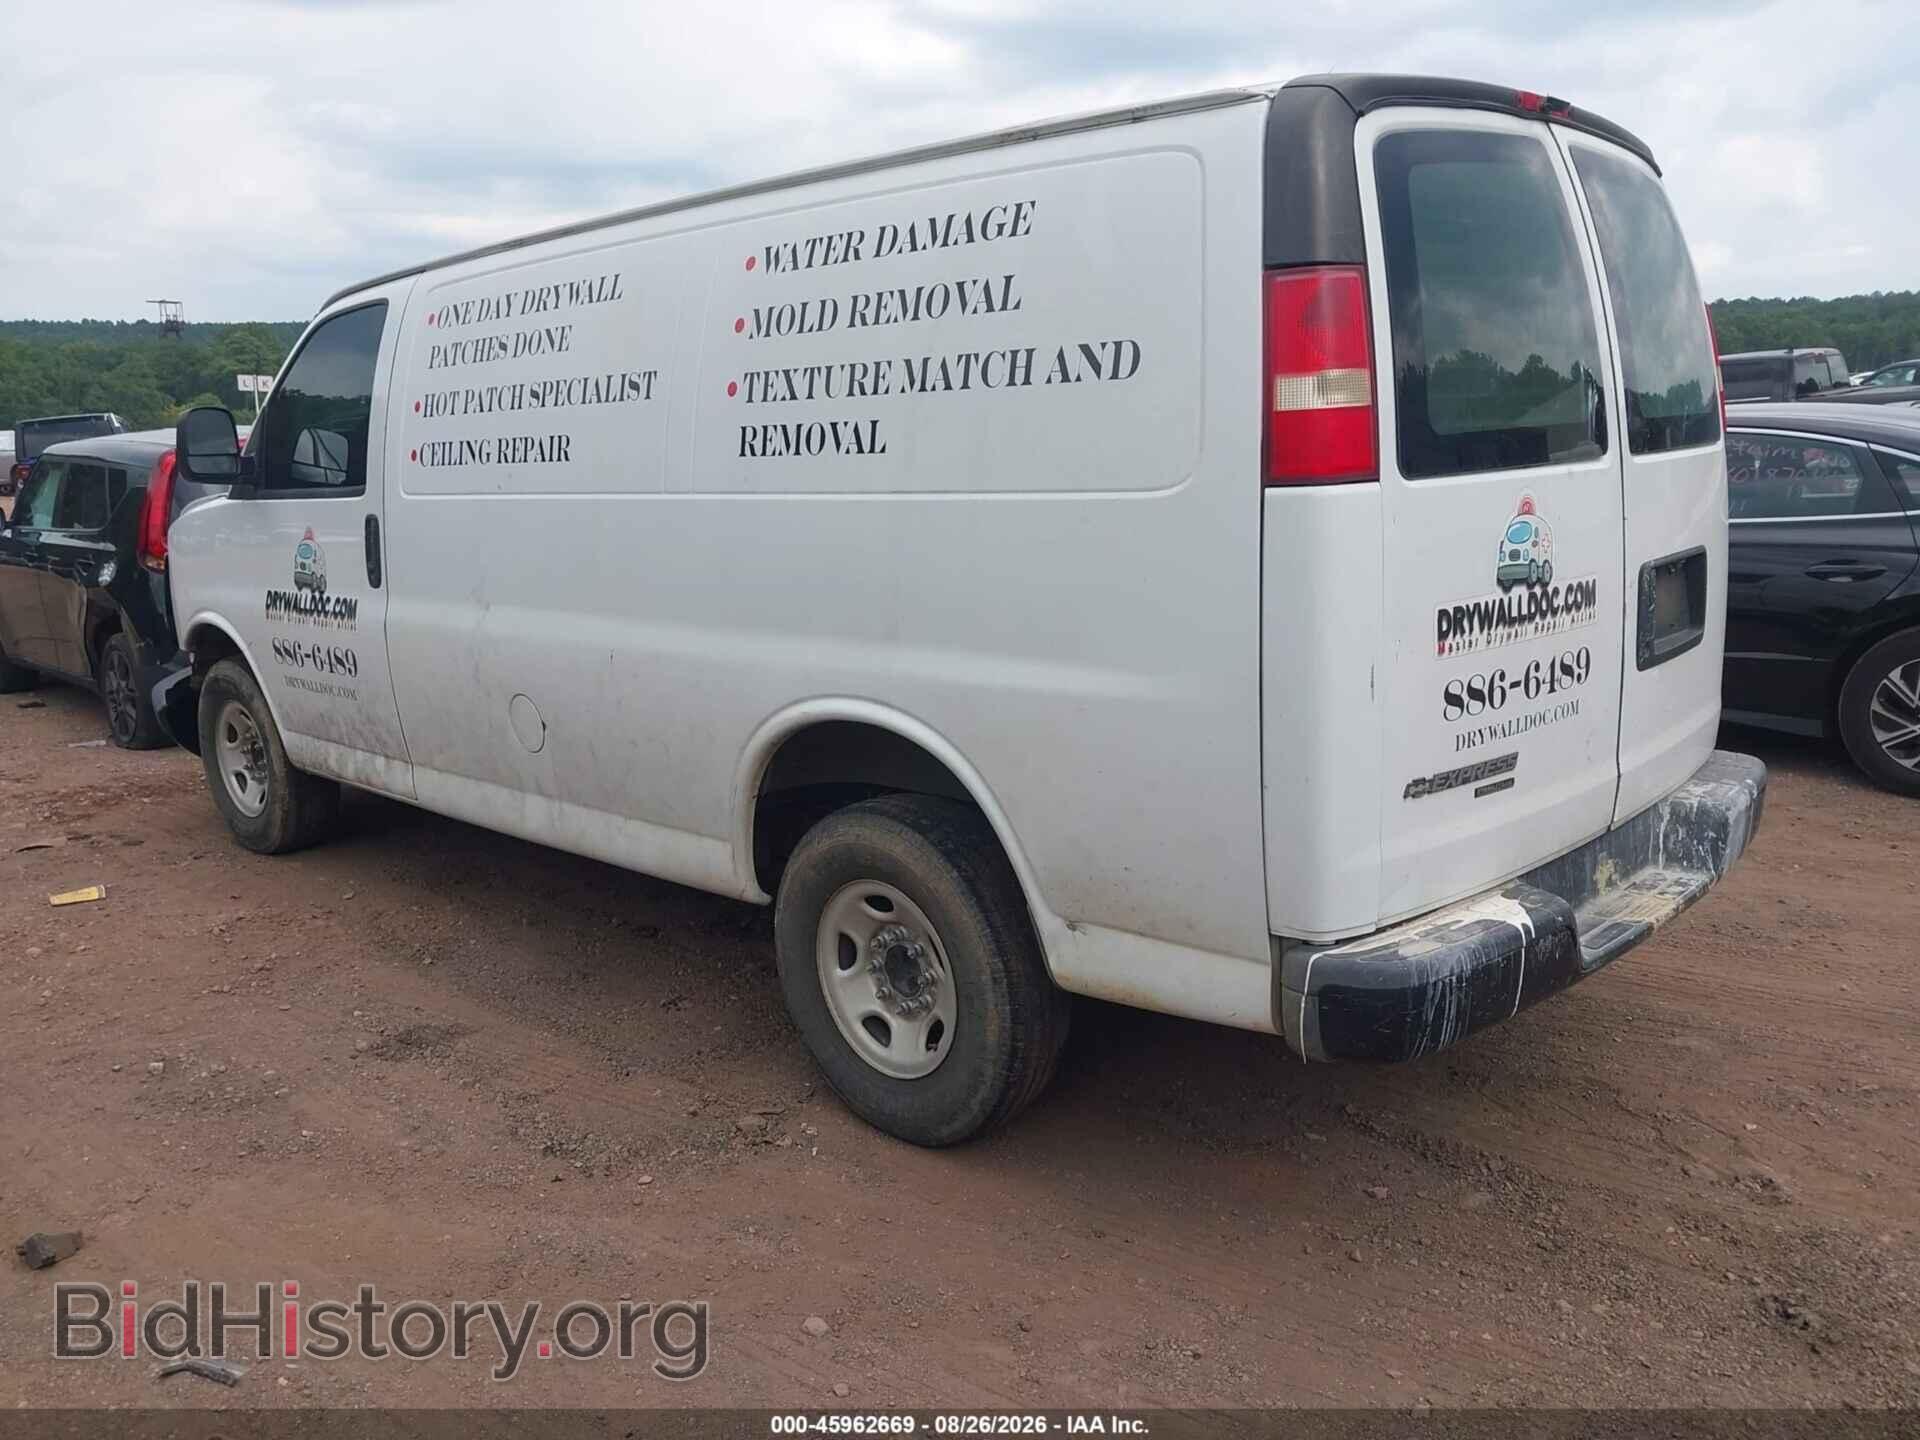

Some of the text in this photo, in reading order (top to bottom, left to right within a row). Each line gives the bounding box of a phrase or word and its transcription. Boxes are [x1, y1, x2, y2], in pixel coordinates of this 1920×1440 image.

[763, 200, 1037, 274] WATER DAMAGE
[436, 273, 624, 329] ONE DAY DRYWALL
[749, 274, 1022, 339] MOLD REMOVAL
[427, 325, 572, 369] PATCHES DONE
[744, 339, 1141, 403] TEXTURE MATCH AND
[422, 371, 657, 418] HOT PATCH SPECIALIST
[419, 434, 571, 467] CEILING REPAIR
[739, 420, 887, 458] REMOVAL
[265, 590, 358, 622] DRYWALLDOC.COM
[1437, 578, 1597, 641] DRYWALLDOC.COM
[272, 637, 358, 678] 886-6489
[1443, 646, 1591, 722] 886-6489
[1455, 699, 1580, 752] DRYWALLDOC.COM
